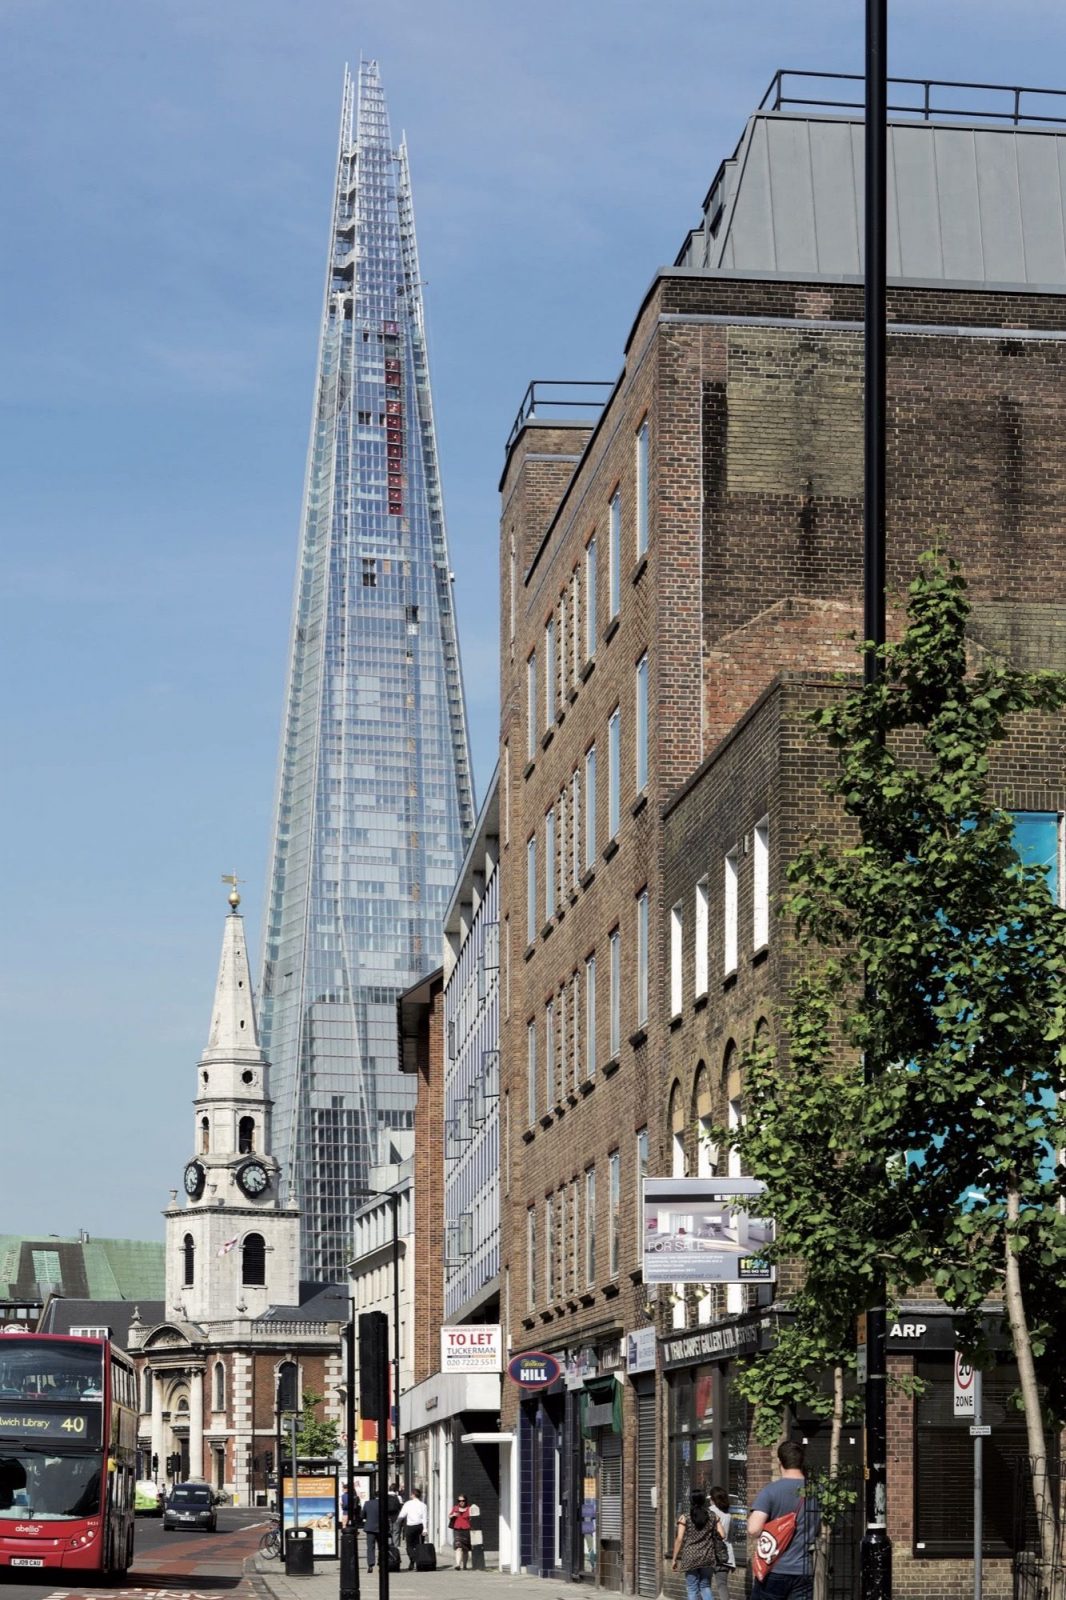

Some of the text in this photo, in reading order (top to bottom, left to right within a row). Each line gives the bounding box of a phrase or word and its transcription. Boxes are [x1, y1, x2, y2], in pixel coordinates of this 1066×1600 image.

[649, 1241, 704, 1251] FOR SALE
[890, 1324, 926, 1337] ARP
[448, 1334, 493, 1345] TO LET
[520, 1369, 547, 1381] HILL
[956, 1396, 973, 1407] ZONE
[22, 1417, 50, 1430] Library
[61, 1417, 85, 1433] 40
